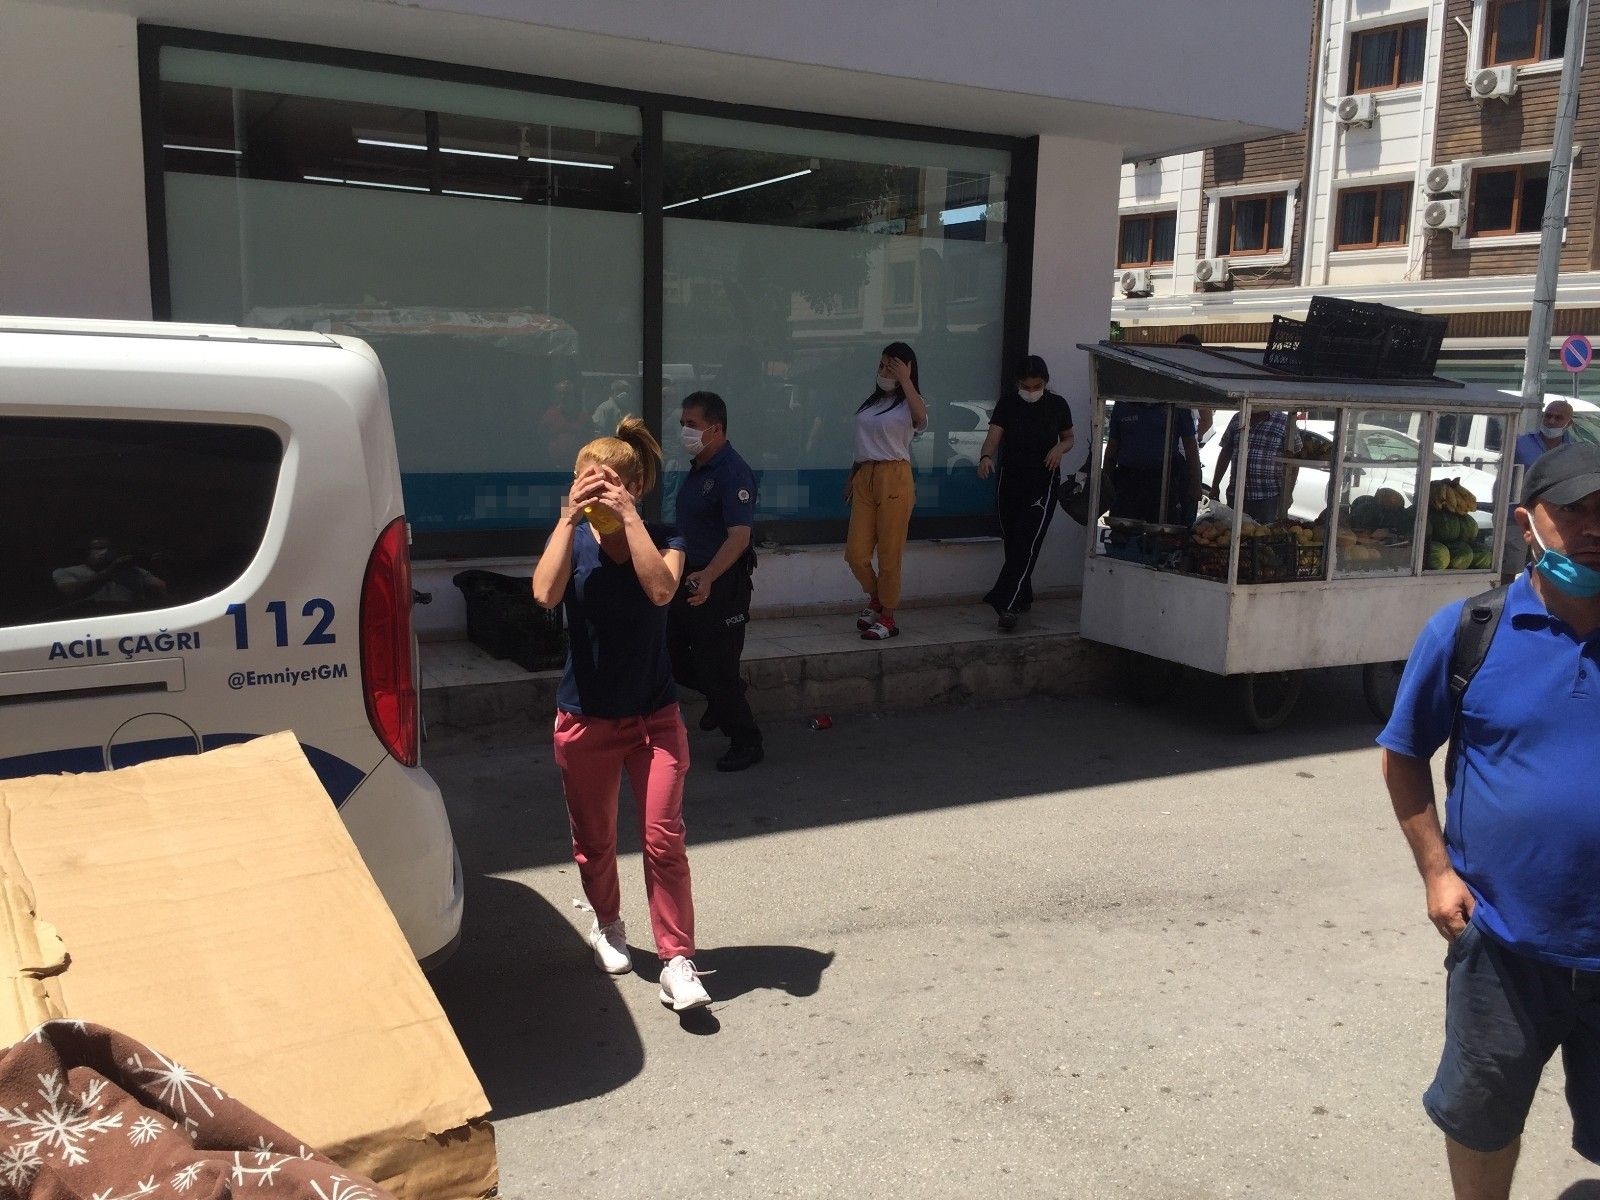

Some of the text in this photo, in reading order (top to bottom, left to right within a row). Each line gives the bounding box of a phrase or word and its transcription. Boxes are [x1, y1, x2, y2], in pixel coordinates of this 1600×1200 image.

[49, 598, 336, 661] ACİL ÇAĞRI 112
[228, 664, 348, 690] @EmniyetGM
